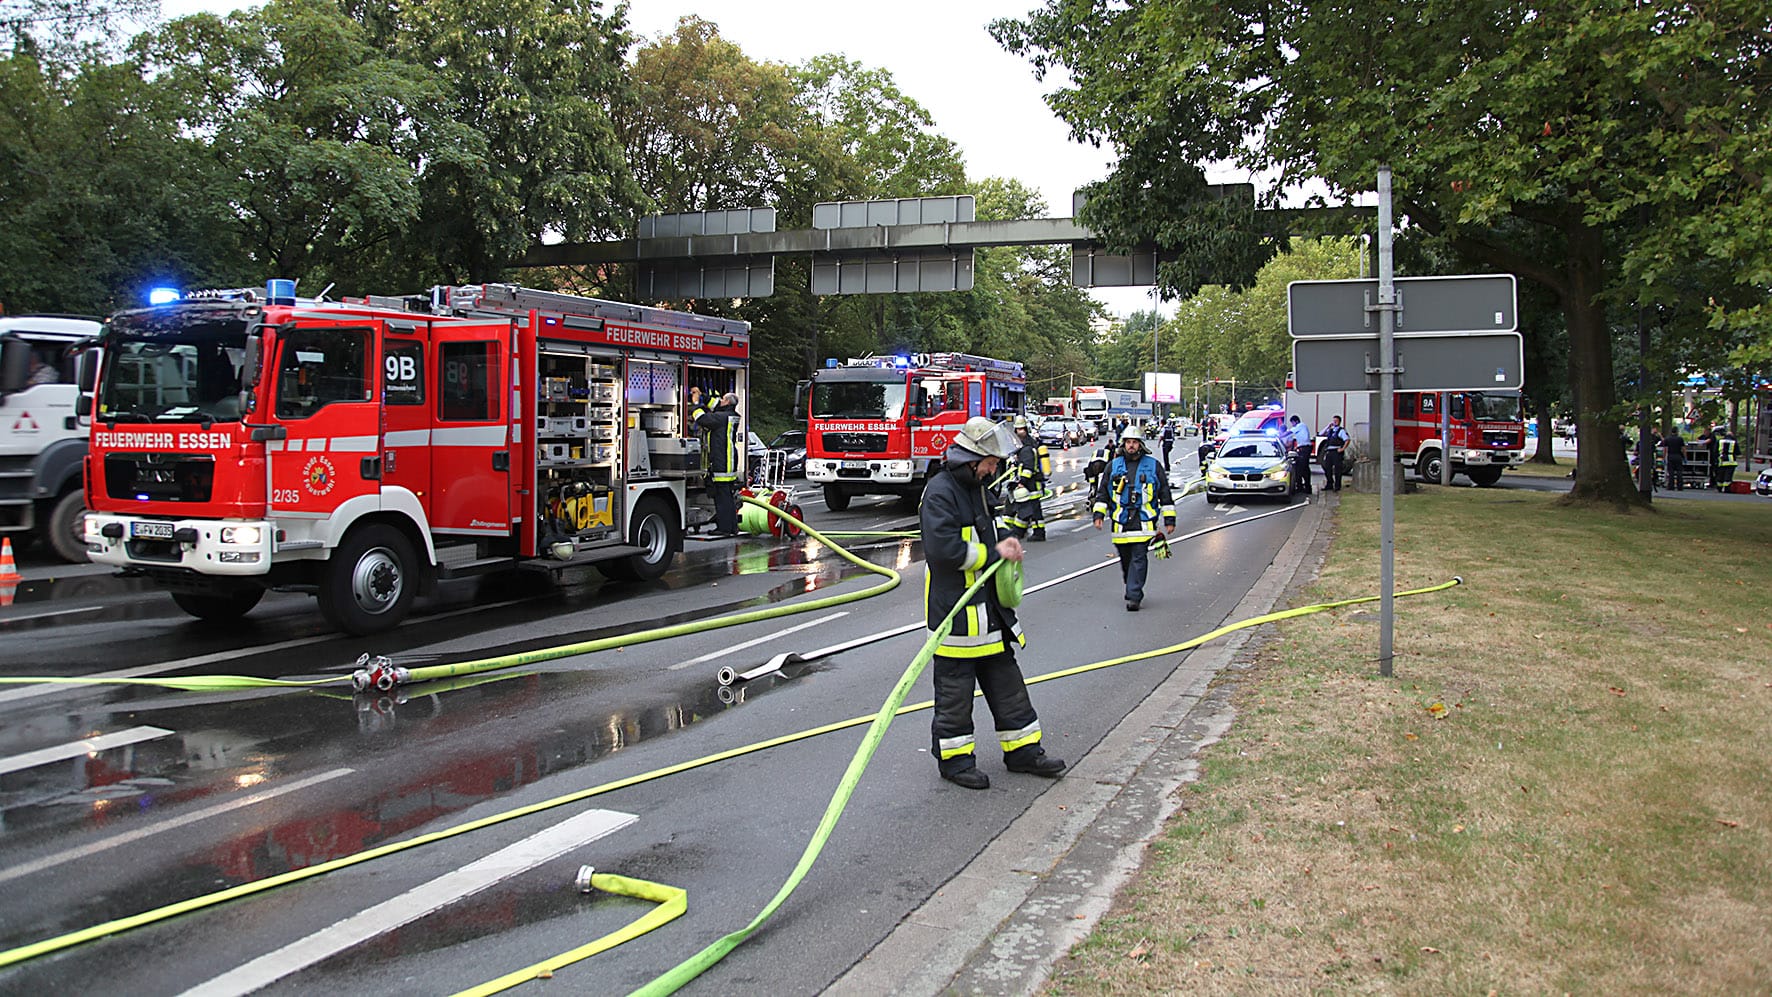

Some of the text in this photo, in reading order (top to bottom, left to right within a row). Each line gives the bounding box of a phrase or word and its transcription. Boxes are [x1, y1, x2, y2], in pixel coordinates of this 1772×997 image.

[606, 327, 703, 351] FEUERWEHR ESSEN
[385, 355, 416, 381] 9B
[1423, 398, 1434, 408] 9A
[815, 423, 897, 431] FEUERWEHR ESSEN
[95, 432, 231, 449] FEUERWEHR ESSEN
[302, 455, 336, 477] Stadt Essen
[136, 470, 176, 482] MAN
[303, 478, 336, 496] Feuerwehr
[273, 489, 300, 503] 2/35
[154, 525, 172, 537] 2035
